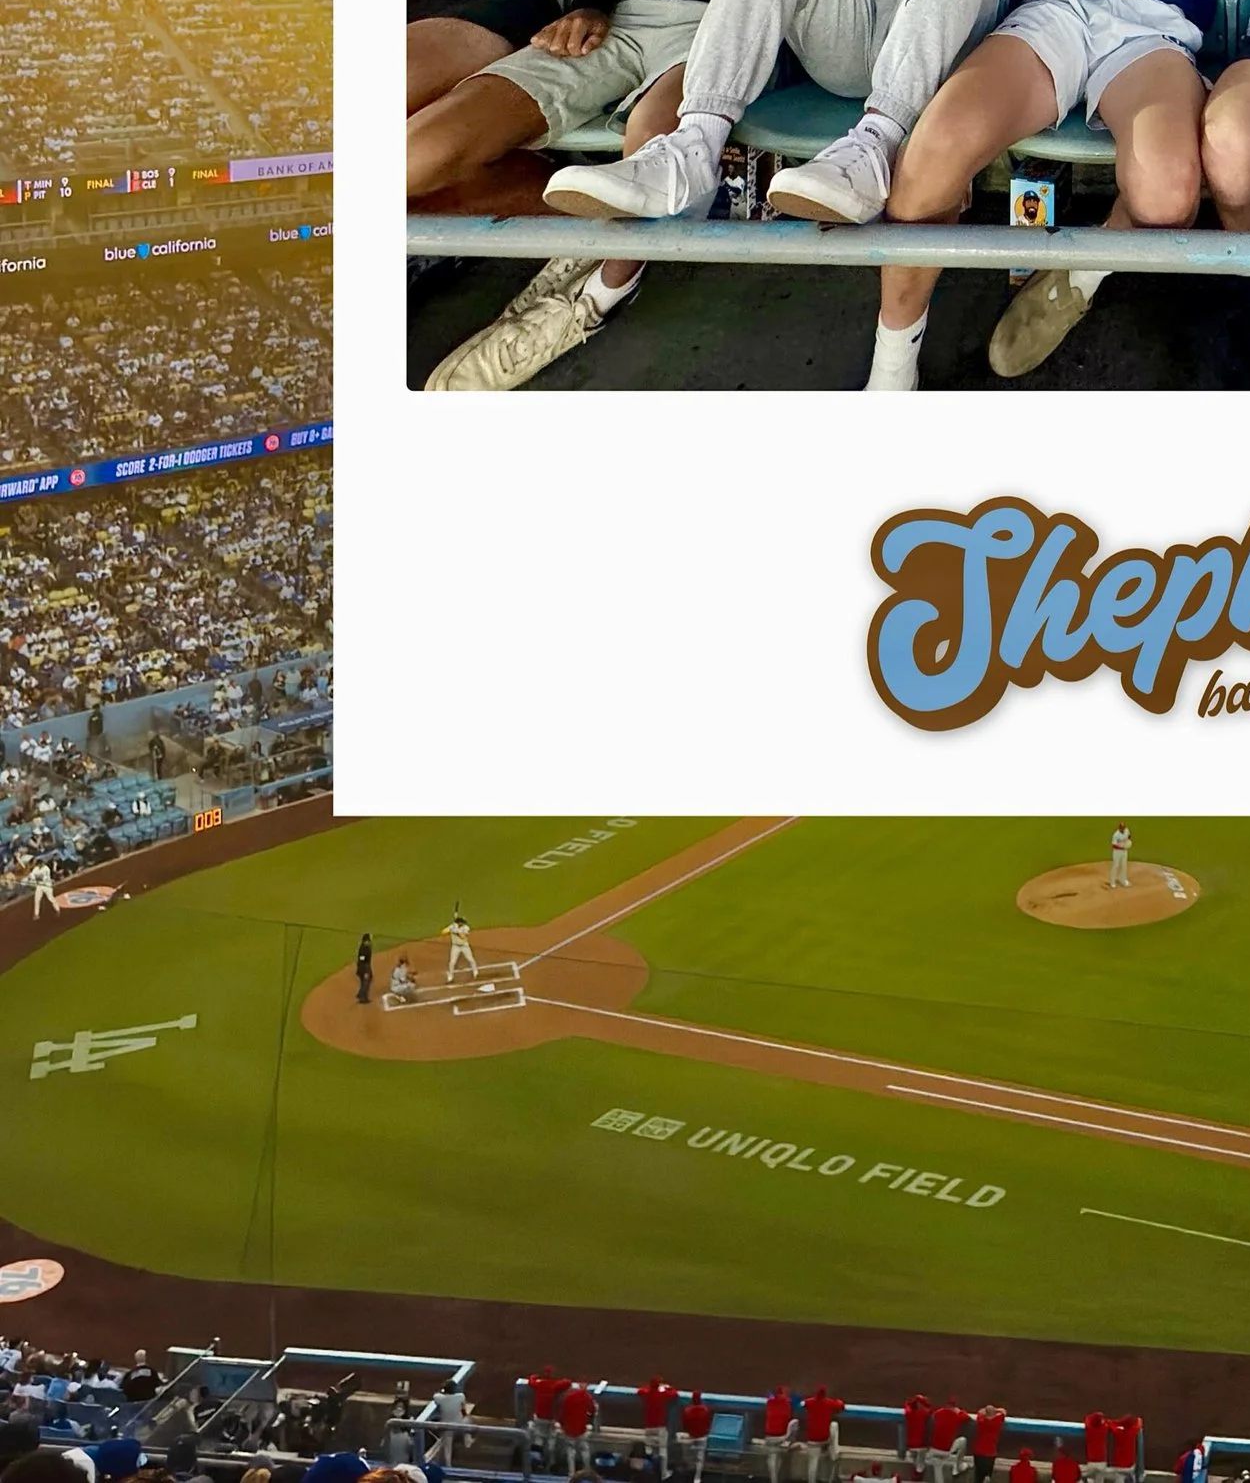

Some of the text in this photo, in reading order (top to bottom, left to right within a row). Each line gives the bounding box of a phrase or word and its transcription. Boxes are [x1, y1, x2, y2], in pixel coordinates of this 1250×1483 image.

[141, 170, 159, 179] BOS
[168, 168, 176, 177] 9
[192, 169, 218, 179] FINAL
[257, 164, 294, 177] BANK
[298, 162, 313, 173] OF
[33, 179, 52, 189] MIN
[61, 177, 69, 187] 9
[86, 179, 114, 190] FINAL
[142, 177, 174, 189] CLE 1
[33, 190, 46, 199] PIT
[60, 188, 72, 198] 10
[269, 228, 298, 243] blue
[104, 237, 216, 261] blue california
[290, 429, 309, 446] BUY
[116, 459, 145, 477] SCORE
[149, 454, 181, 472] 2-FOR-1
[184, 446, 217, 465] DODGER
[220, 440, 253, 459] TICKETS
[0, 480, 36, 498] RWARD
[39, 475, 59, 491] APP
[195, 808, 222, 832] 008
[523, 829, 618, 870] FIELD
[687, 1126, 856, 1176] UNIQLO
[858, 1162, 1007, 1209] FIELD
